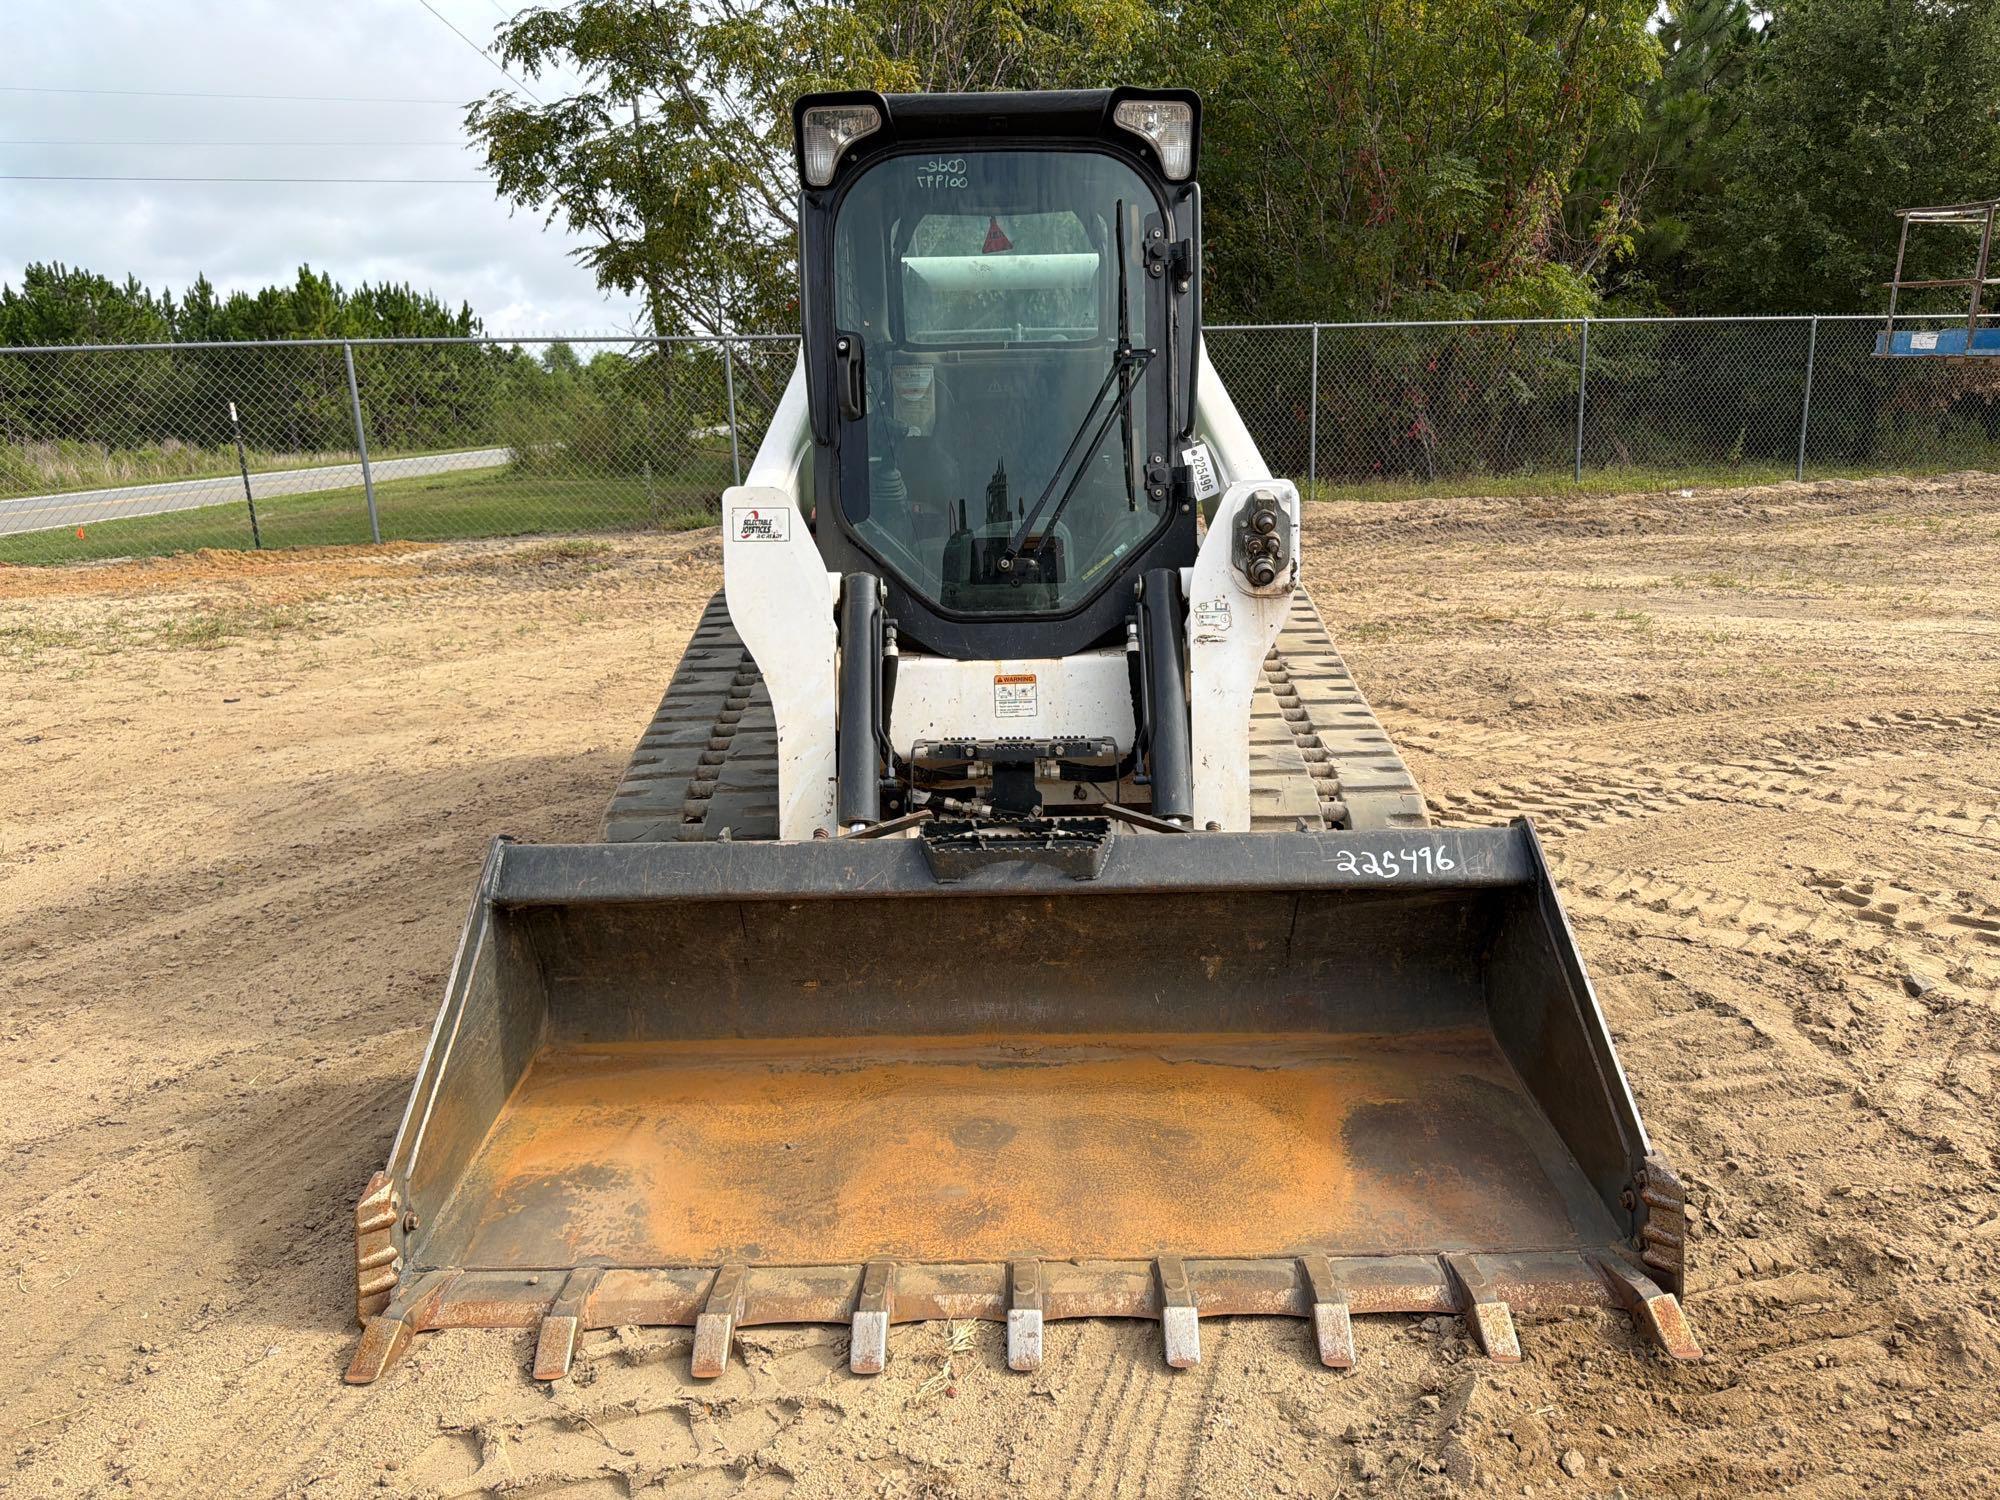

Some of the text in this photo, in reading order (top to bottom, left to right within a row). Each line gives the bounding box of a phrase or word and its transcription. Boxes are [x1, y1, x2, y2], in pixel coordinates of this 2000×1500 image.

[1192, 456, 1213, 492] 225496
[741, 526, 771, 534] JOYSTICKS
[1336, 845, 1455, 878] 225496
